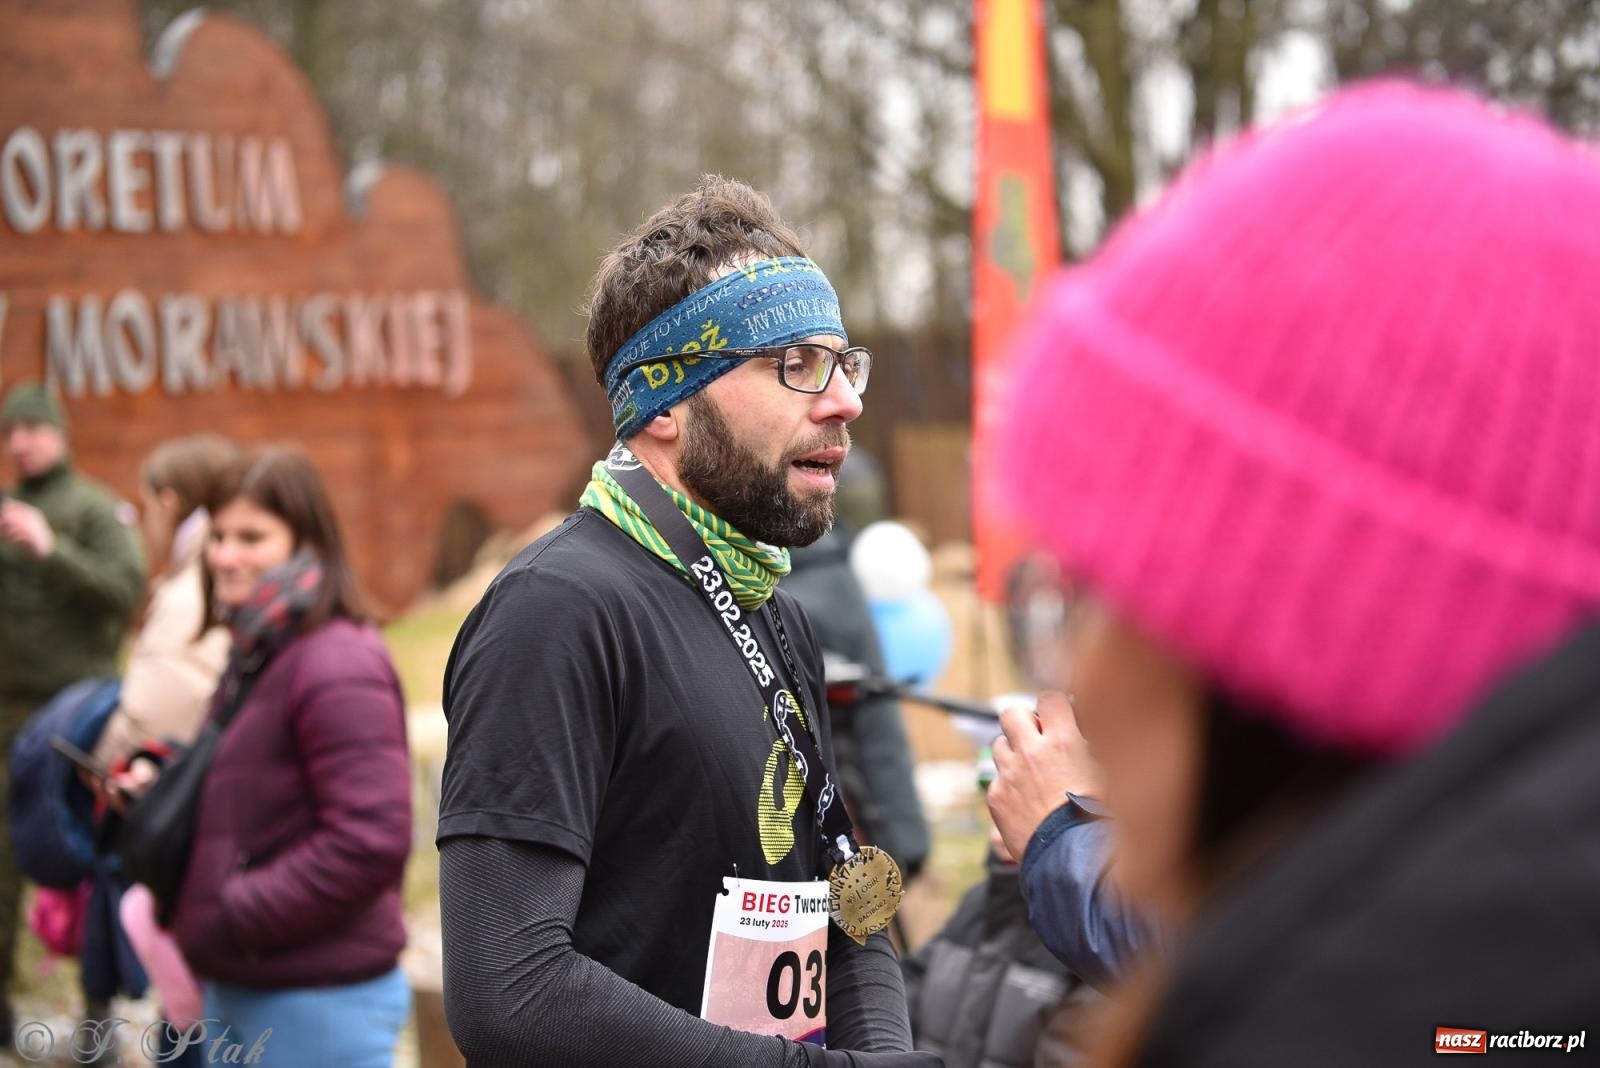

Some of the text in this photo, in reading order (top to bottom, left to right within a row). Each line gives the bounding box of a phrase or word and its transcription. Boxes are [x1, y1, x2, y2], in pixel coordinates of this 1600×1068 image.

[1, 127, 302, 234] ORETUM
[47, 289, 471, 397] MORAWSKIEJ
[673, 313, 682, 327] V
[690, 555, 776, 688] 23.02.2025
[740, 917, 789, 930] 23 luty 2025
[742, 891, 831, 914] BIEG Tward
[766, 949, 827, 1020] 03
